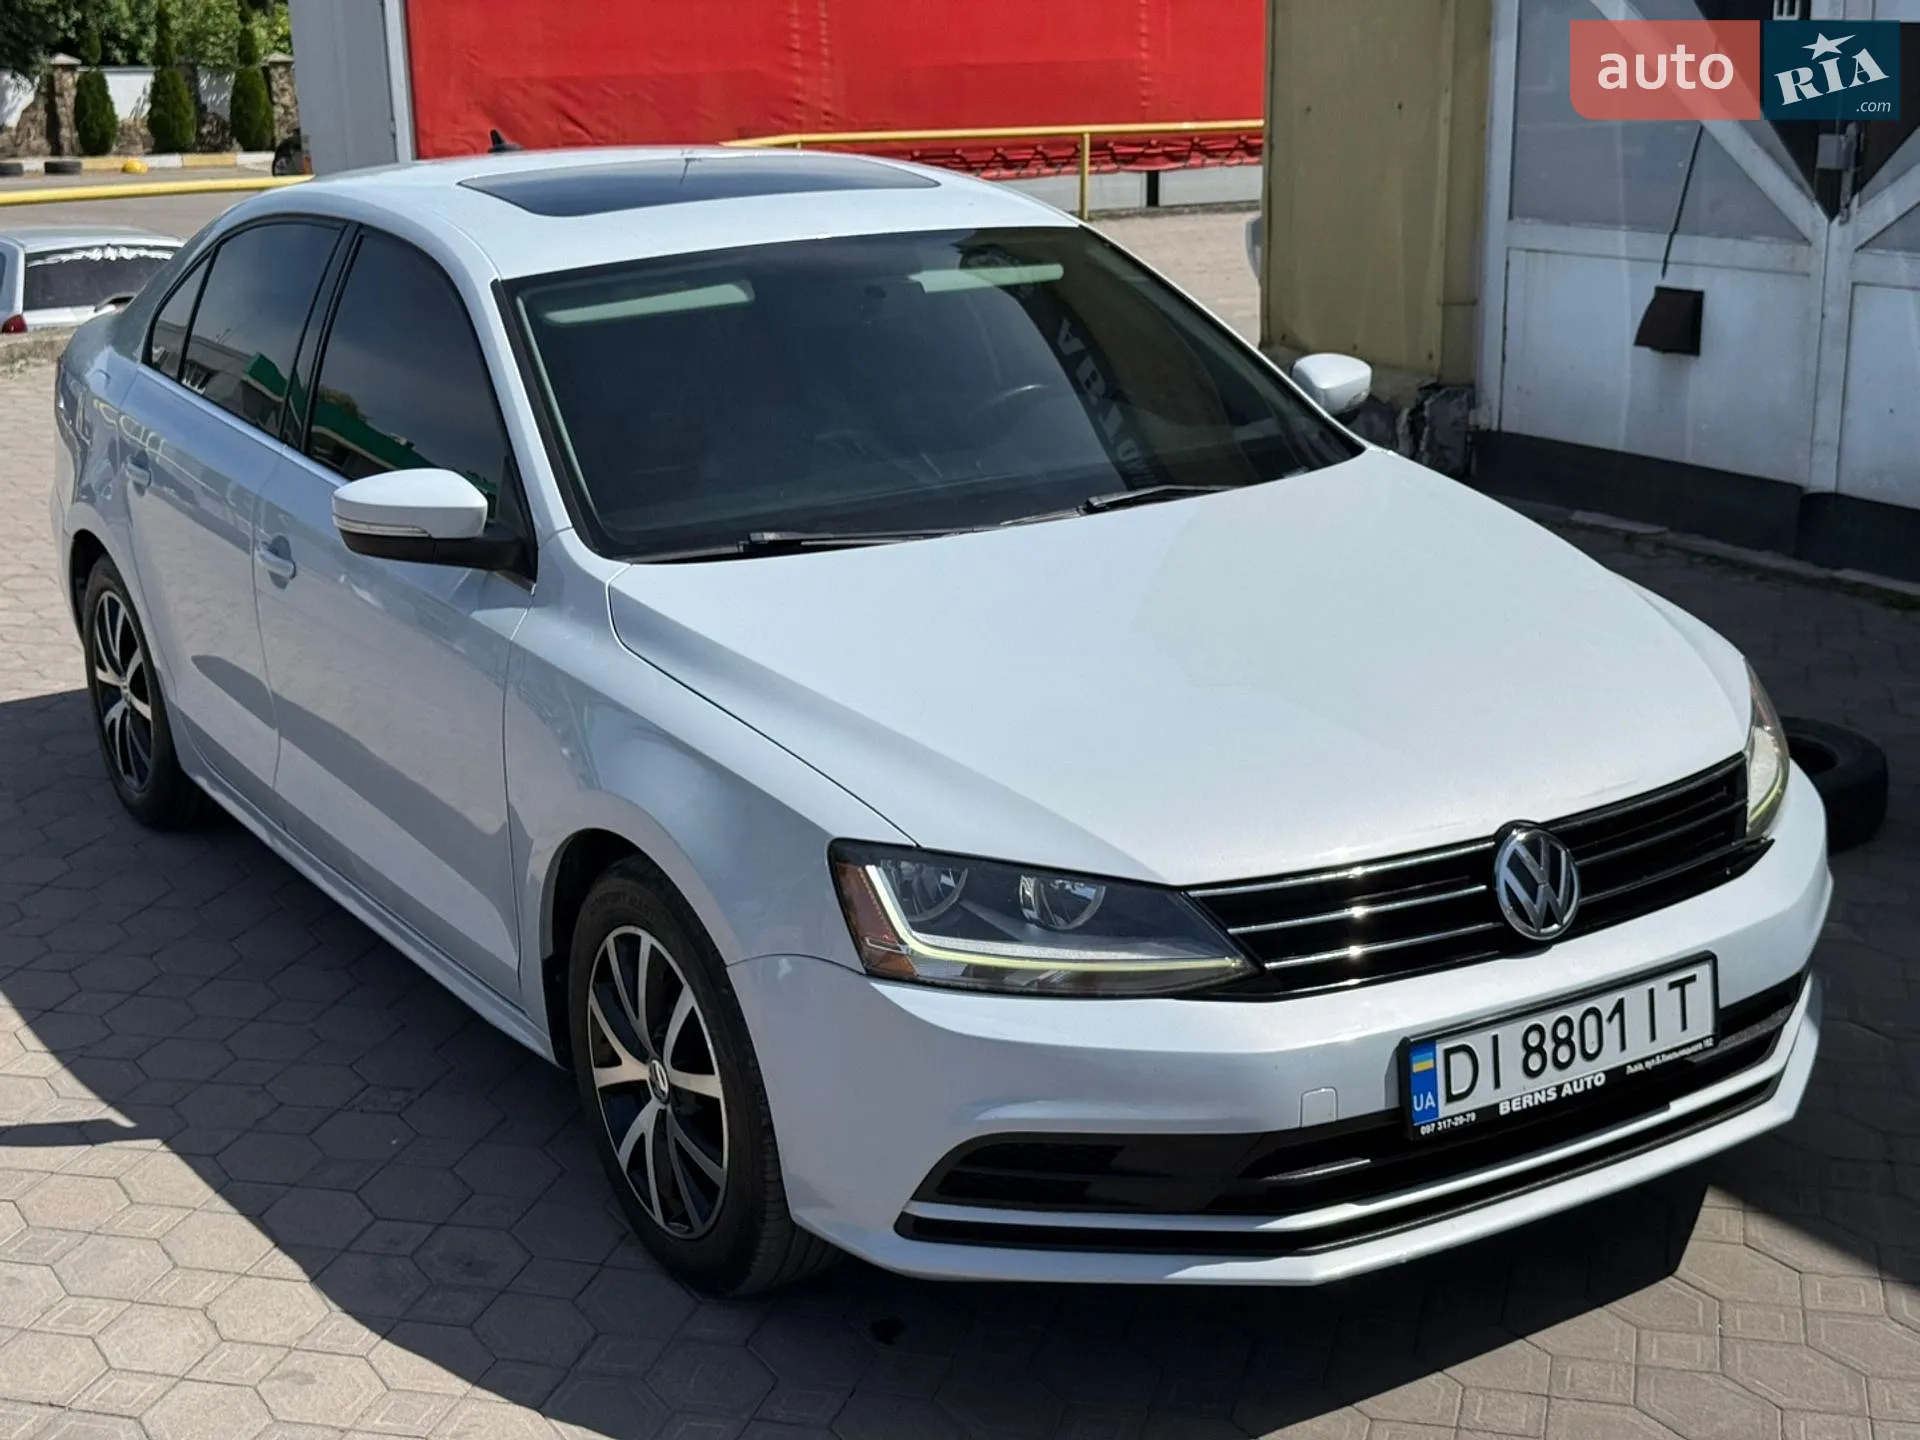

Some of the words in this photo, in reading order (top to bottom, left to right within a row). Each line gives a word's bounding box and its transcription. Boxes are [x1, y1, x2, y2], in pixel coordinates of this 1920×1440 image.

[1444, 1034, 1501, 1104] DI
[1521, 998, 1627, 1079] 8801
[1648, 974, 1697, 1042] IT
[1413, 1093, 1436, 1112] UA
[1499, 1086, 1557, 1116] BERNS
[1561, 1072, 1606, 1099] AUTO
